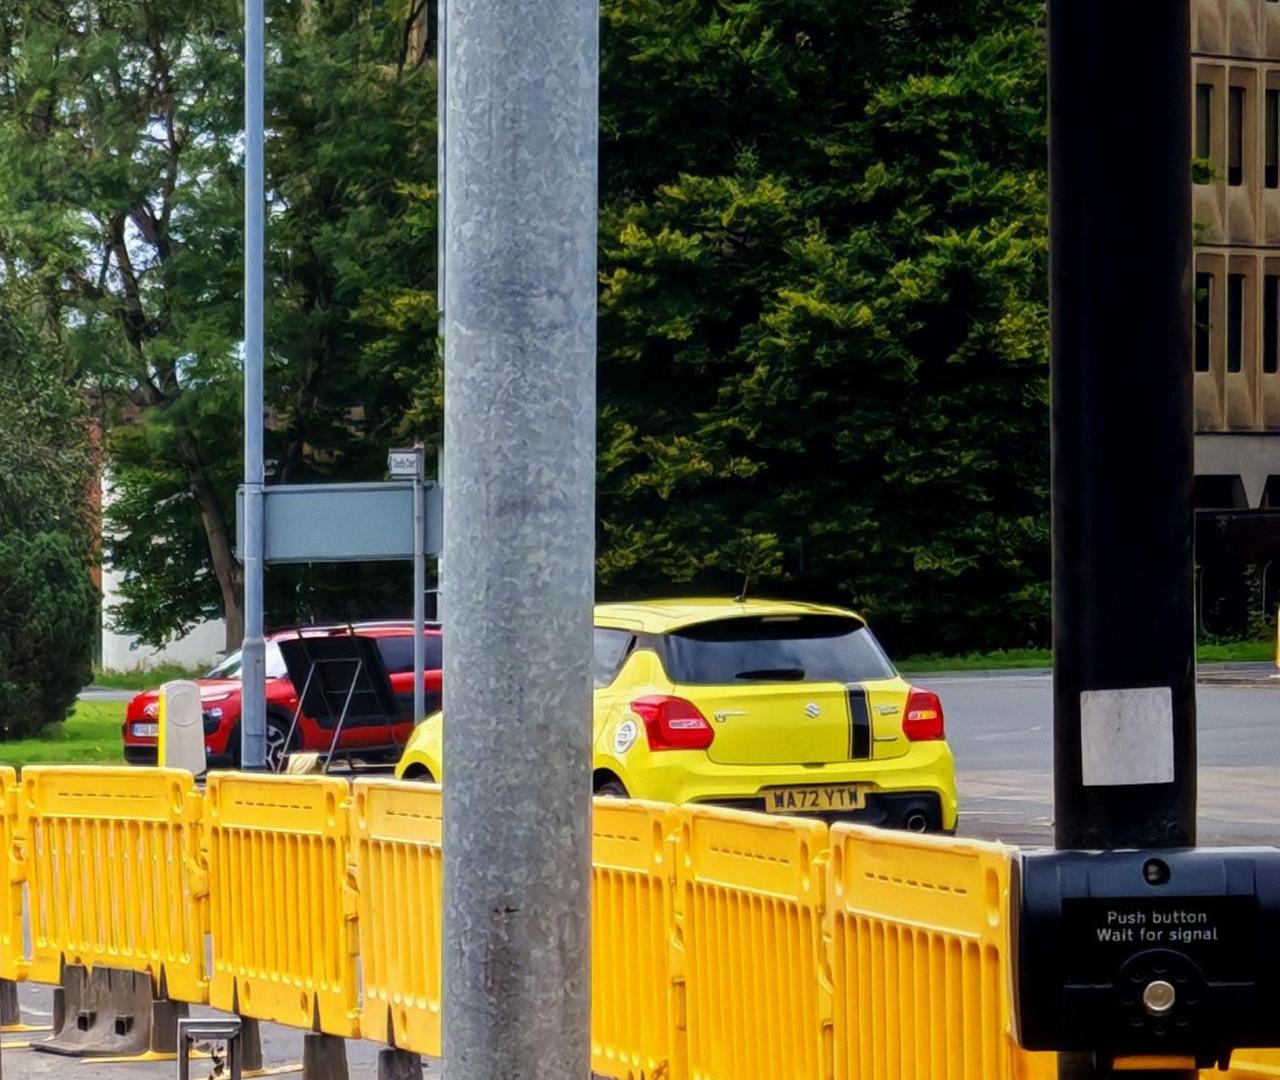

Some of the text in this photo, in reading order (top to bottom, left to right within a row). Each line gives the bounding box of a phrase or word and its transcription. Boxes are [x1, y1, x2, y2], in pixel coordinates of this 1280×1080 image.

[1107, 910, 1207, 924] Push button
[1097, 927, 1219, 944] Wait for signal
